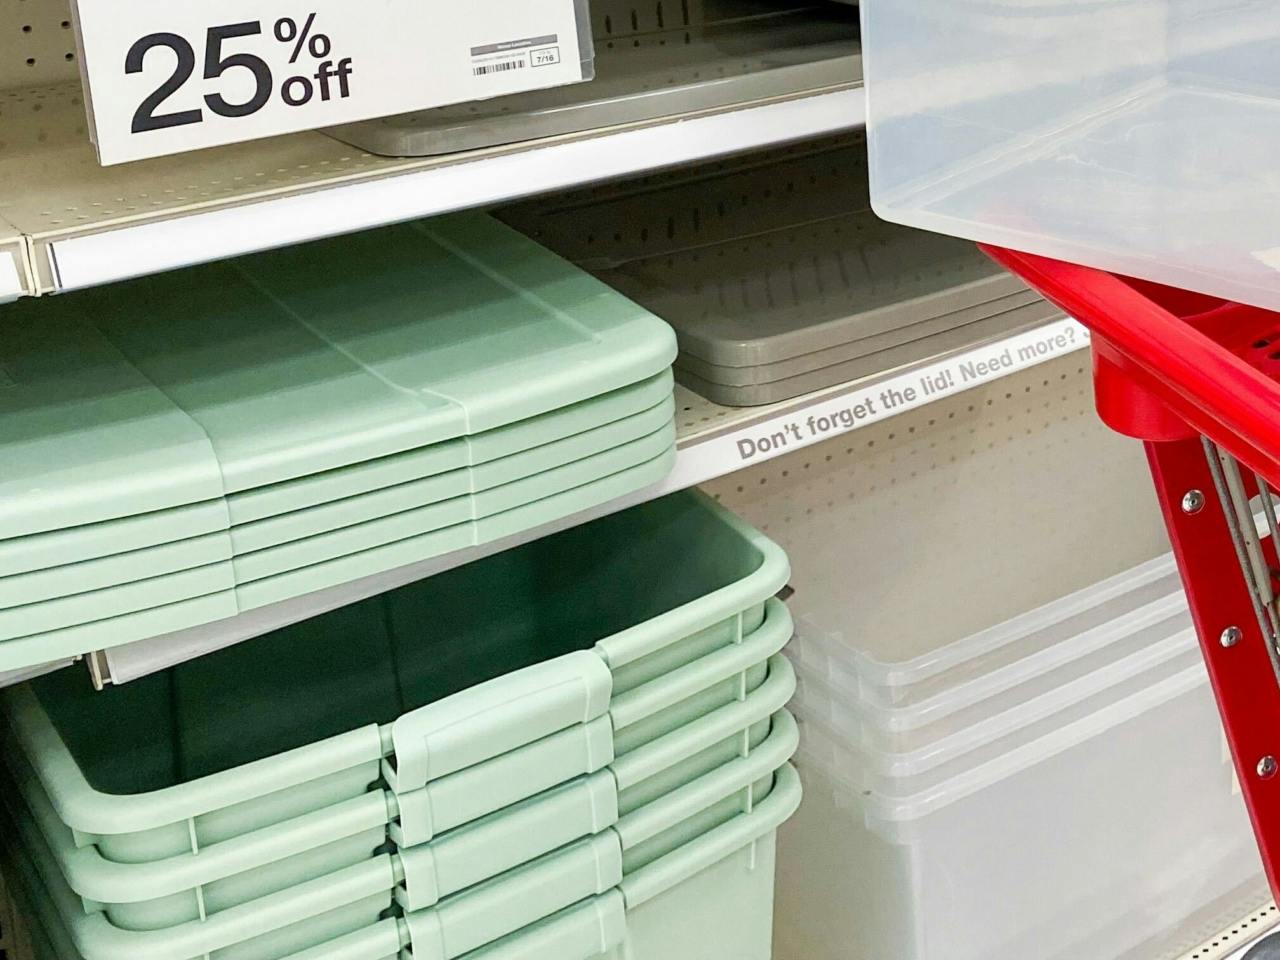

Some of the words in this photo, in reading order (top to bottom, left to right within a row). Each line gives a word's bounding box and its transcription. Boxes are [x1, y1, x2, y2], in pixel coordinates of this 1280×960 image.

[280, 57, 352, 106] off
[536, 54, 554, 63] 7/16
[736, 423, 803, 460] Don't
[806, 397, 876, 435] forget
[881, 386, 916, 409] the
[920, 369, 954, 396] lid!
[959, 351, 1013, 382] Need
[1018, 326, 1076, 362] more?
